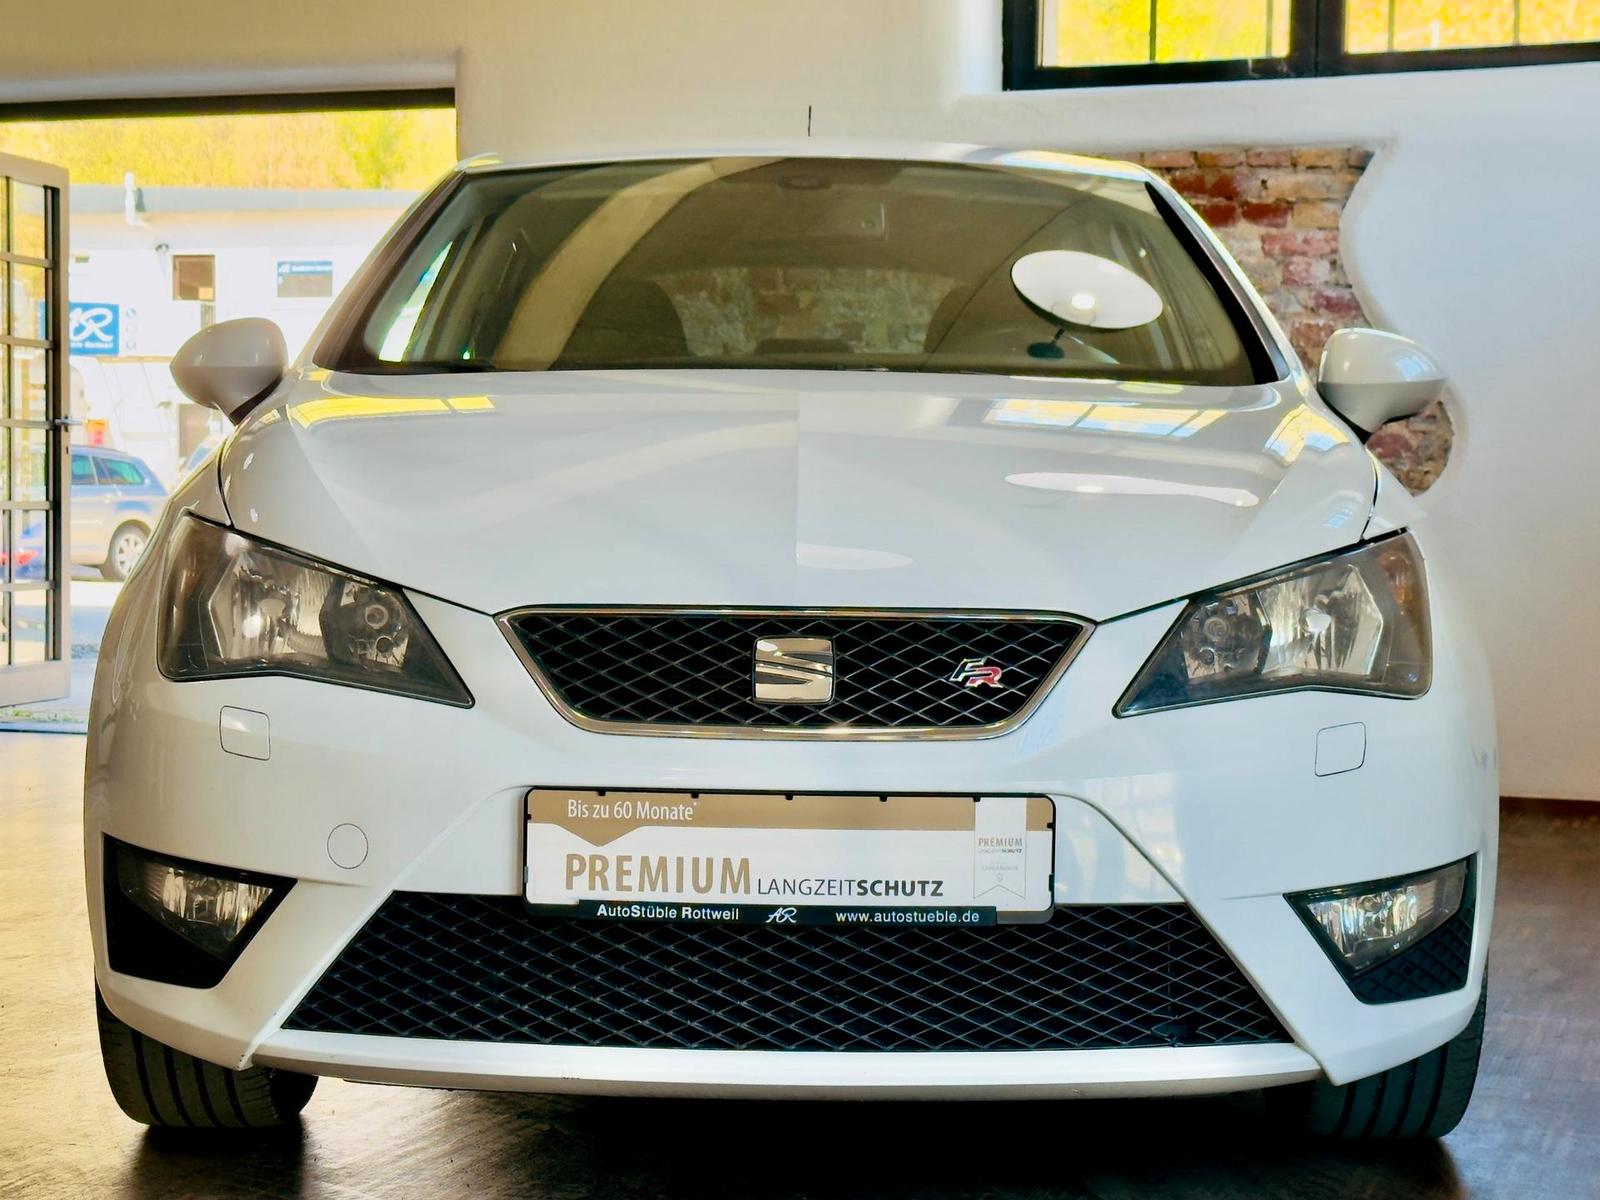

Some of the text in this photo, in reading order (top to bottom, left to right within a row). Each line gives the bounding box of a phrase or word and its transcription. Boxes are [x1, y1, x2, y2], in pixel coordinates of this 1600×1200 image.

[949, 656, 1004, 688] FR
[567, 799, 589, 818] Bis
[592, 803, 609, 818] zu
[613, 801, 632, 819] 60
[977, 837, 1023, 848] PREMIUM
[565, 853, 944, 897] PREMIUM LANGZEITSCHUTZ
[596, 904, 739, 921] AutoStüble Rottweil
[835, 909, 981, 924] www.autostueble.de
